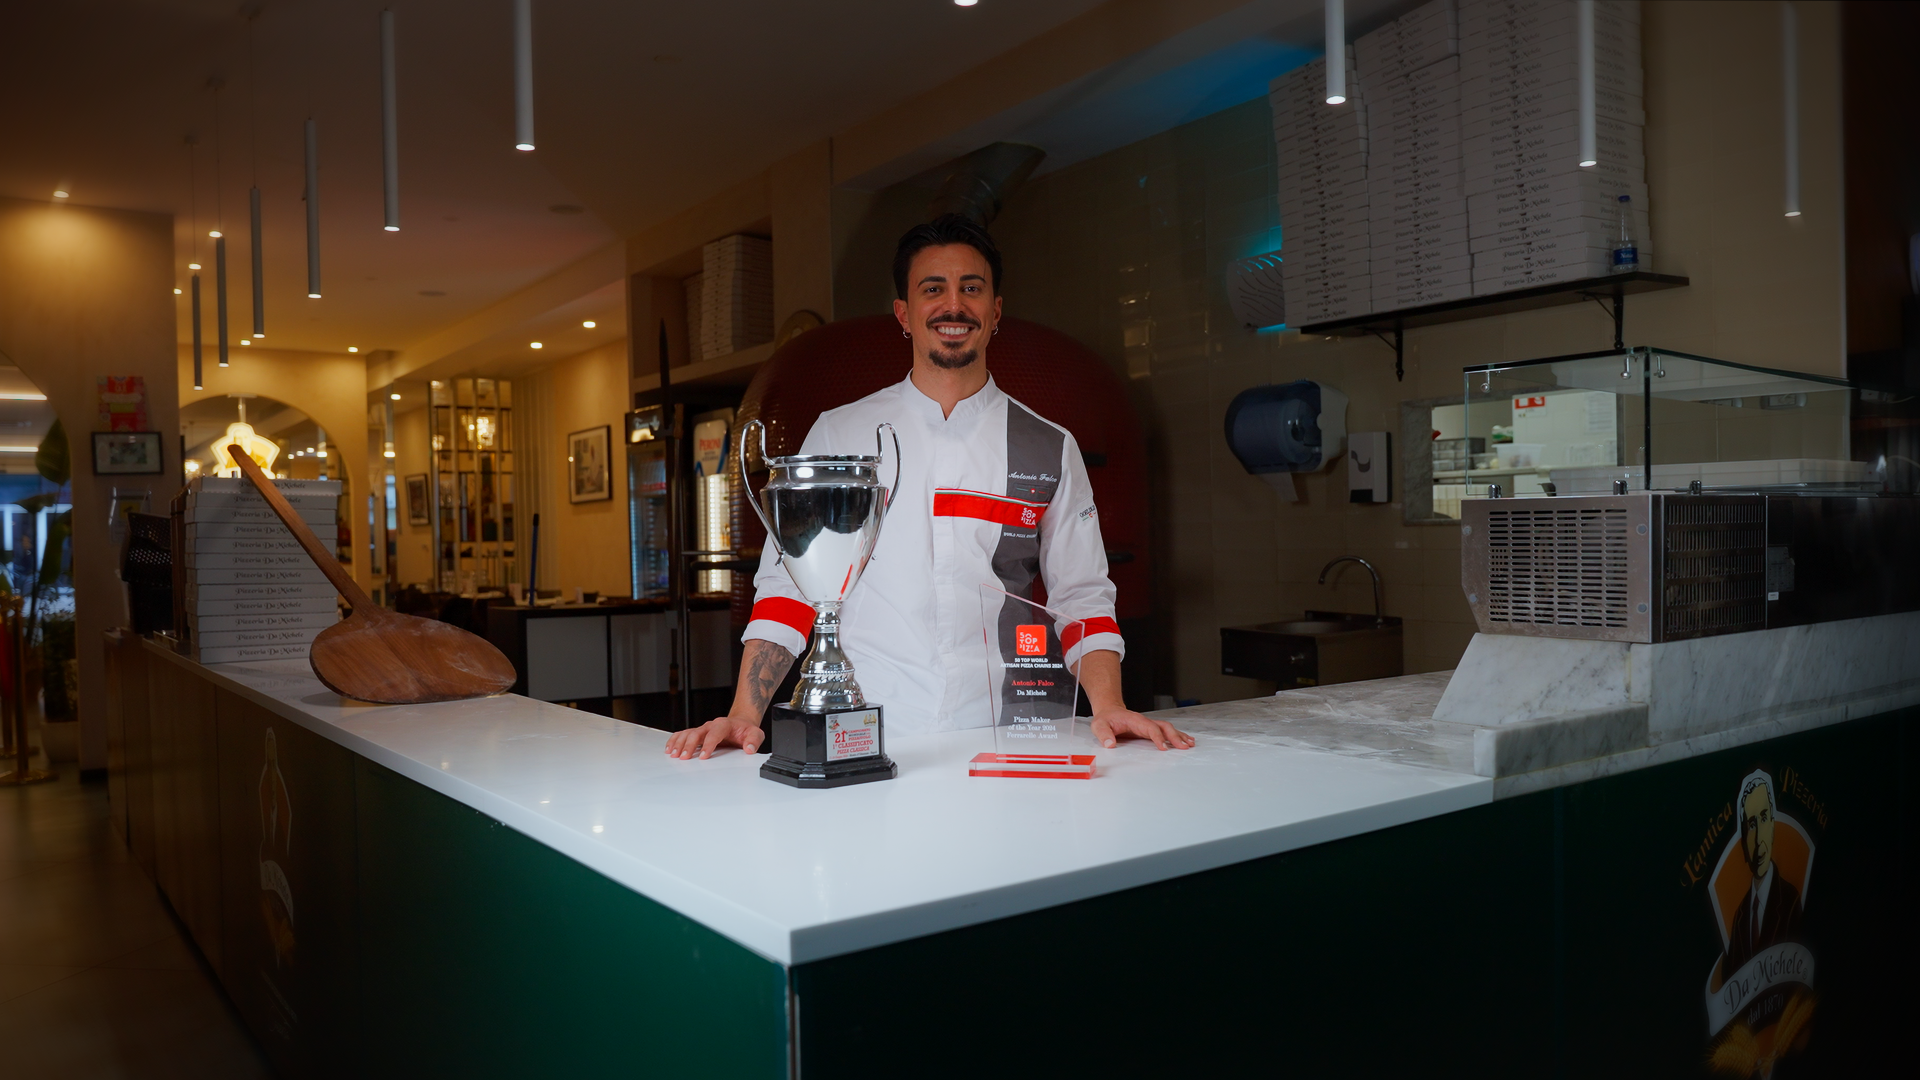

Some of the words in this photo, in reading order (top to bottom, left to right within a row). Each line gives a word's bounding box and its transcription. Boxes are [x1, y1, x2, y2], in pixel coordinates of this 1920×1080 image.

[1008, 471, 1037, 480] Antonio
[280, 480, 306, 488] Michele
[236, 634, 265, 642] Pizzeria
[237, 649, 266, 657] Pizzeria
[838, 740, 873, 748] CLASSIFICATO
[1779, 765, 1828, 829] Pizzeria
[1724, 979, 1749, 1014] Da
[1747, 1003, 1761, 1026] dal
[1764, 993, 1784, 1016] 1870
